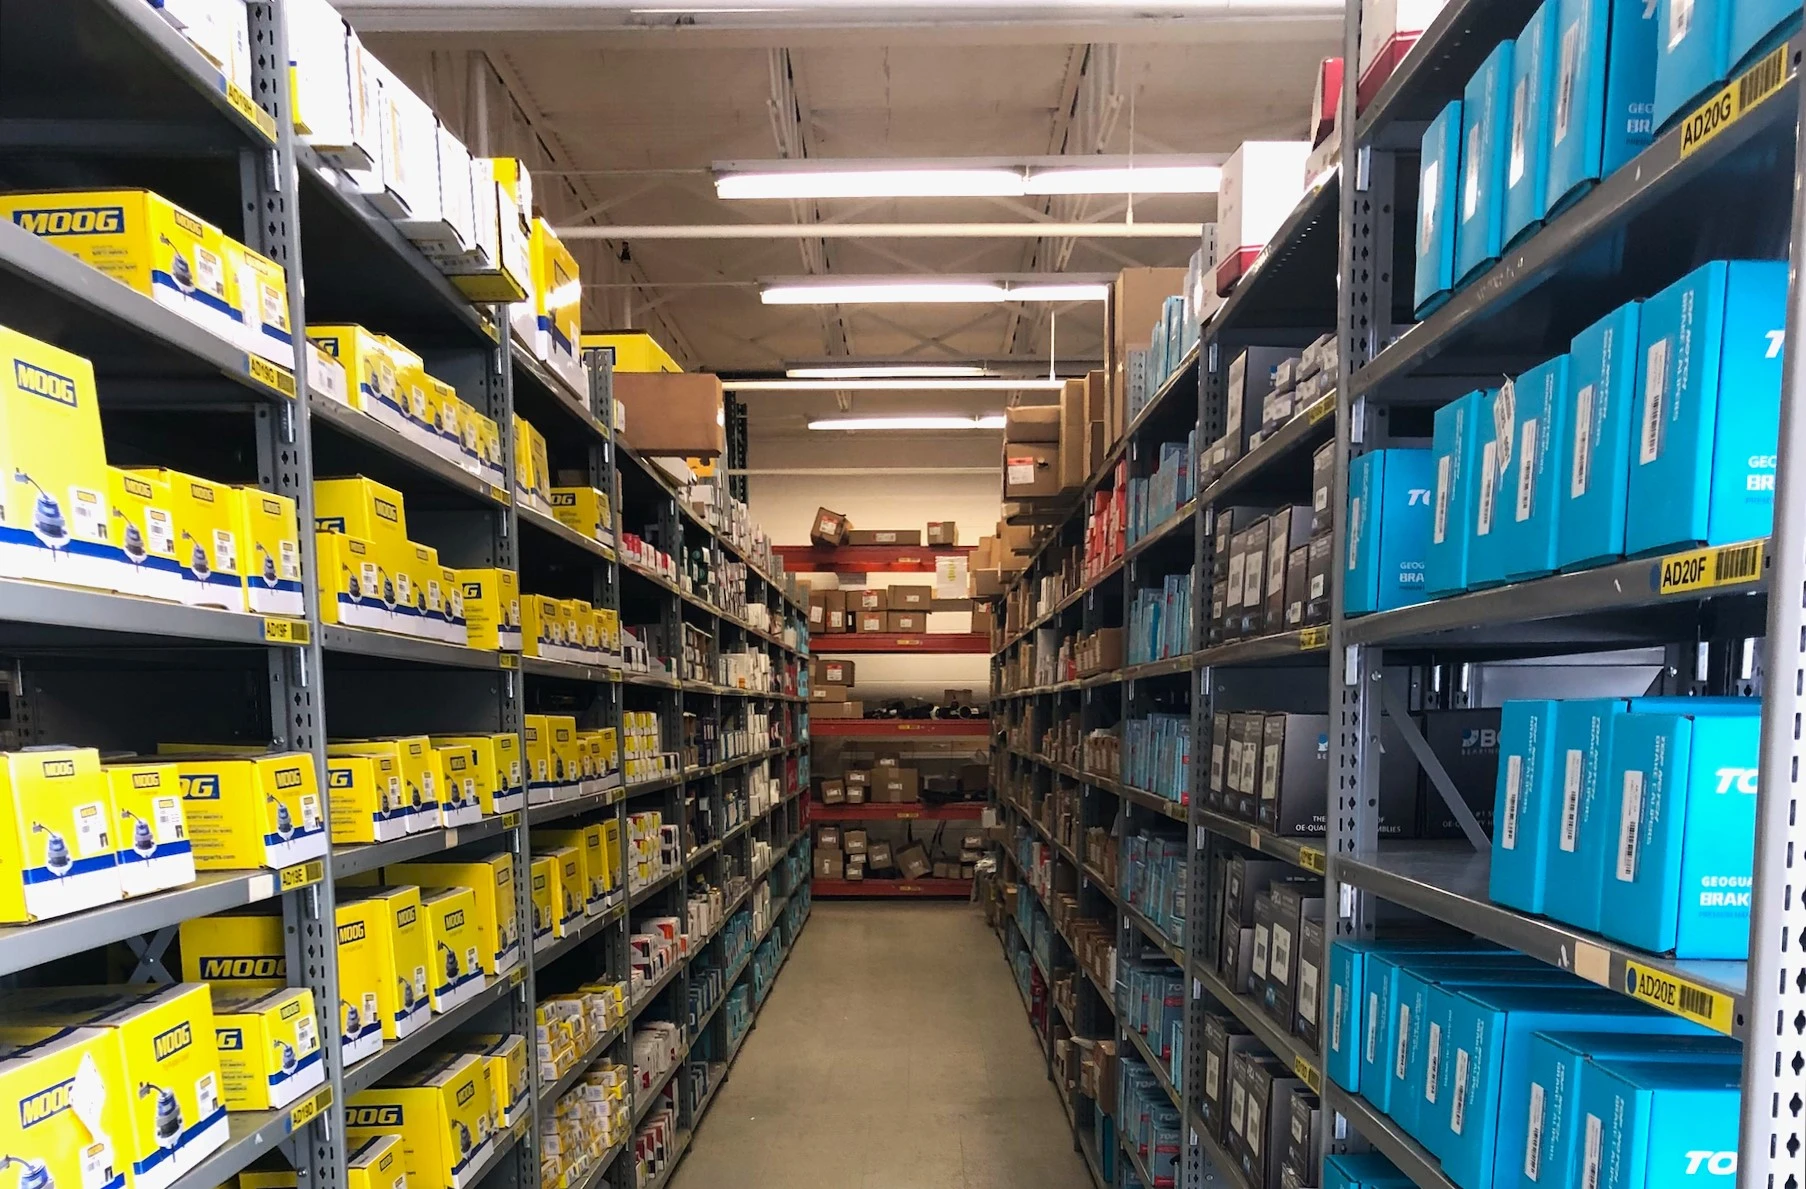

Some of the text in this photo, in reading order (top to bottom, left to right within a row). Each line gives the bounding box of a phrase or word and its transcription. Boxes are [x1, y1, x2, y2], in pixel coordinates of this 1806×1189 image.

[1683, 94, 1732, 148] AD20G
[20, 211, 118, 234] MOOG
[17, 361, 74, 405] MOOG
[251, 359, 275, 384] AD19G
[1663, 556, 1706, 588] AD20F
[267, 622, 287, 638] AD19F
[282, 868, 303, 887] AD19E
[397, 907, 416, 927] MOOG
[445, 910, 464, 930] MOOG
[340, 923, 365, 944] MOOG
[1639, 973, 1677, 1006] AD20E
[281, 1003, 299, 1020] MOOG
[155, 1022, 191, 1061] MOOG
[292, 1102, 314, 1125] AD19D
[346, 1107, 398, 1126] OOG
